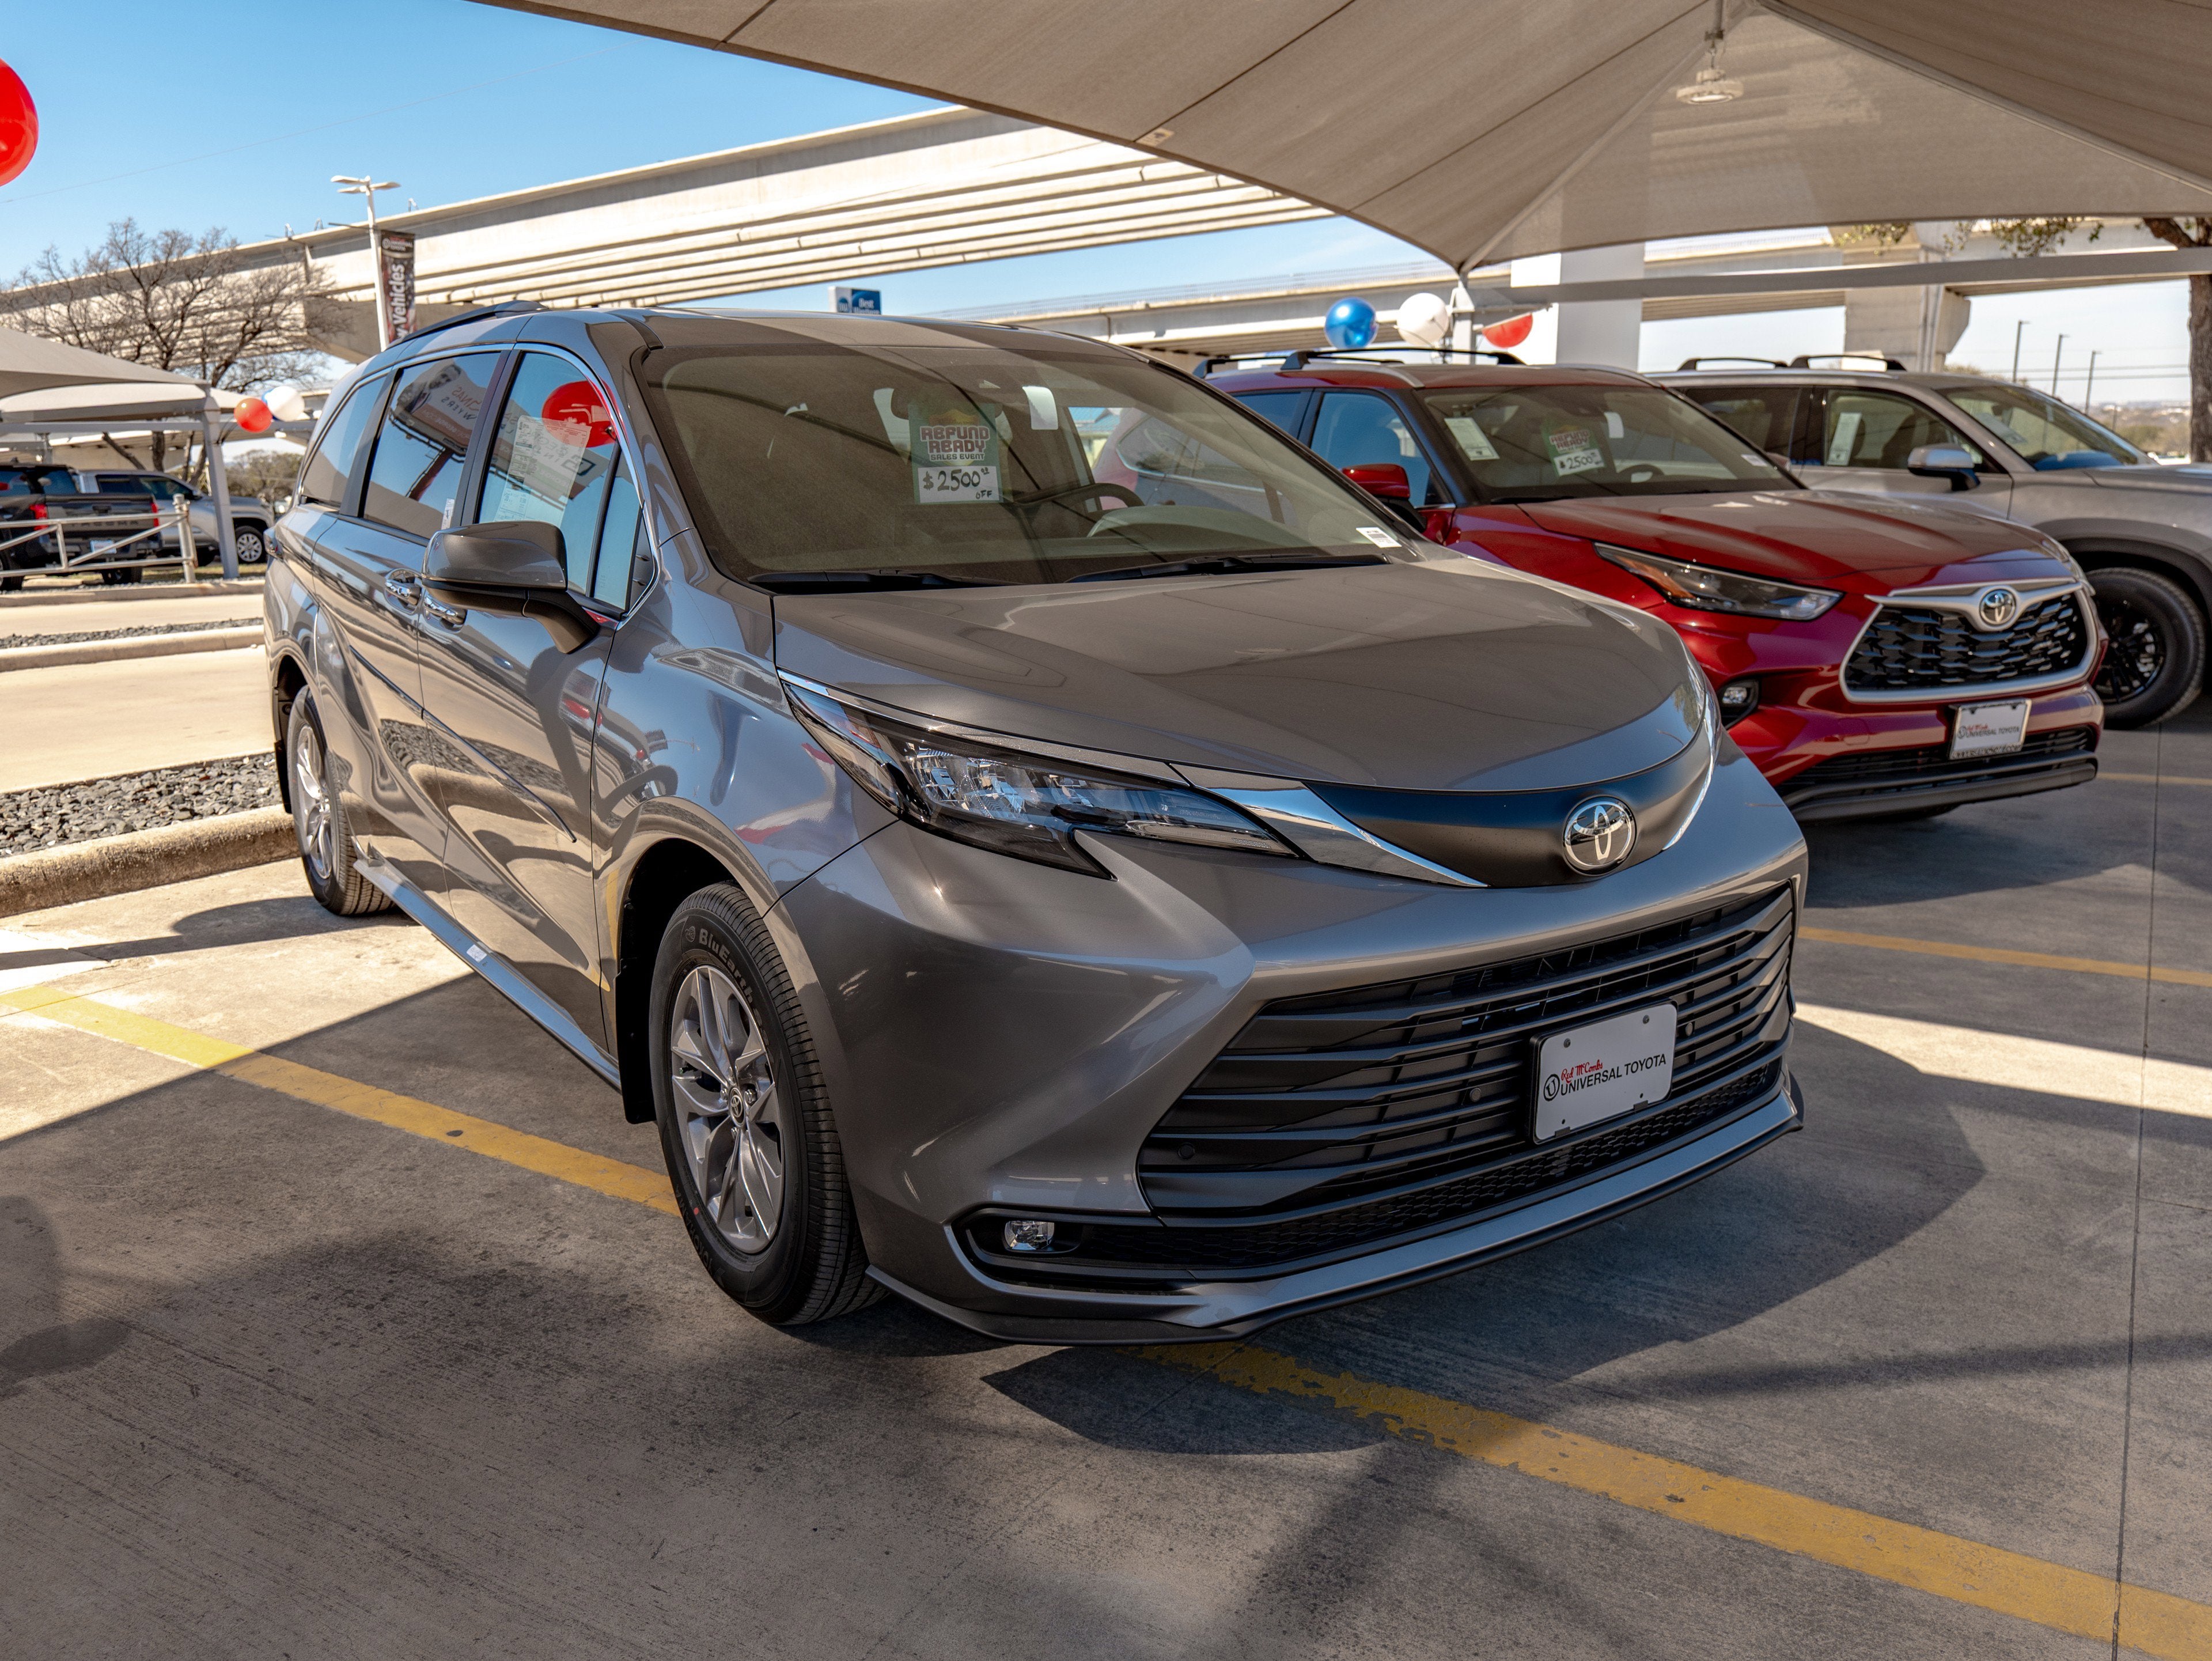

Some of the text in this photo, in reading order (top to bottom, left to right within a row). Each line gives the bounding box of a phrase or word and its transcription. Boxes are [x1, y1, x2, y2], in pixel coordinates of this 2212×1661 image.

[389, 263, 407, 324] Vehicles
[921, 426, 989, 441] REFUND
[929, 440, 986, 453] READY
[975, 490, 993, 500] OFF
[699, 928, 753, 1004] BluEarth
[1560, 1066, 1622, 1096] UNIVERSAL
[1624, 1054, 1666, 1076] TOYOTA
[1561, 1067, 1574, 1083] Red
